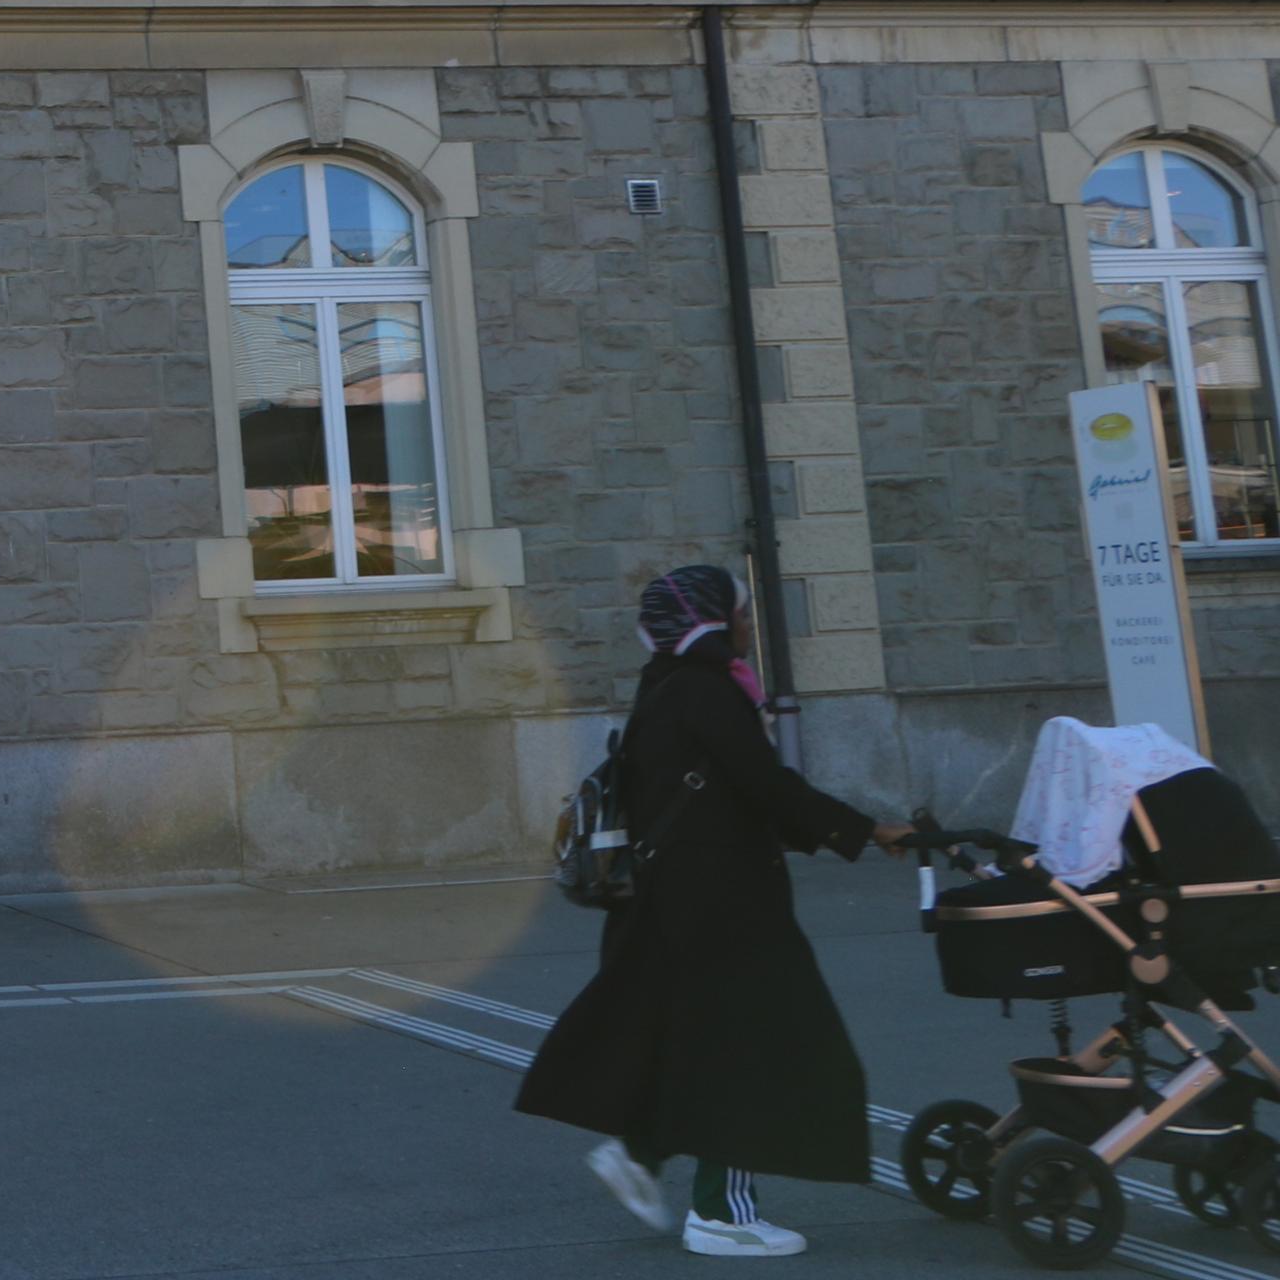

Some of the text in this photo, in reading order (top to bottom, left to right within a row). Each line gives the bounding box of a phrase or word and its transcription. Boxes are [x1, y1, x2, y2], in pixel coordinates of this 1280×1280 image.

[1097, 541, 1161, 566] 7 TAGE
[1126, 572, 1144, 586] SIE
